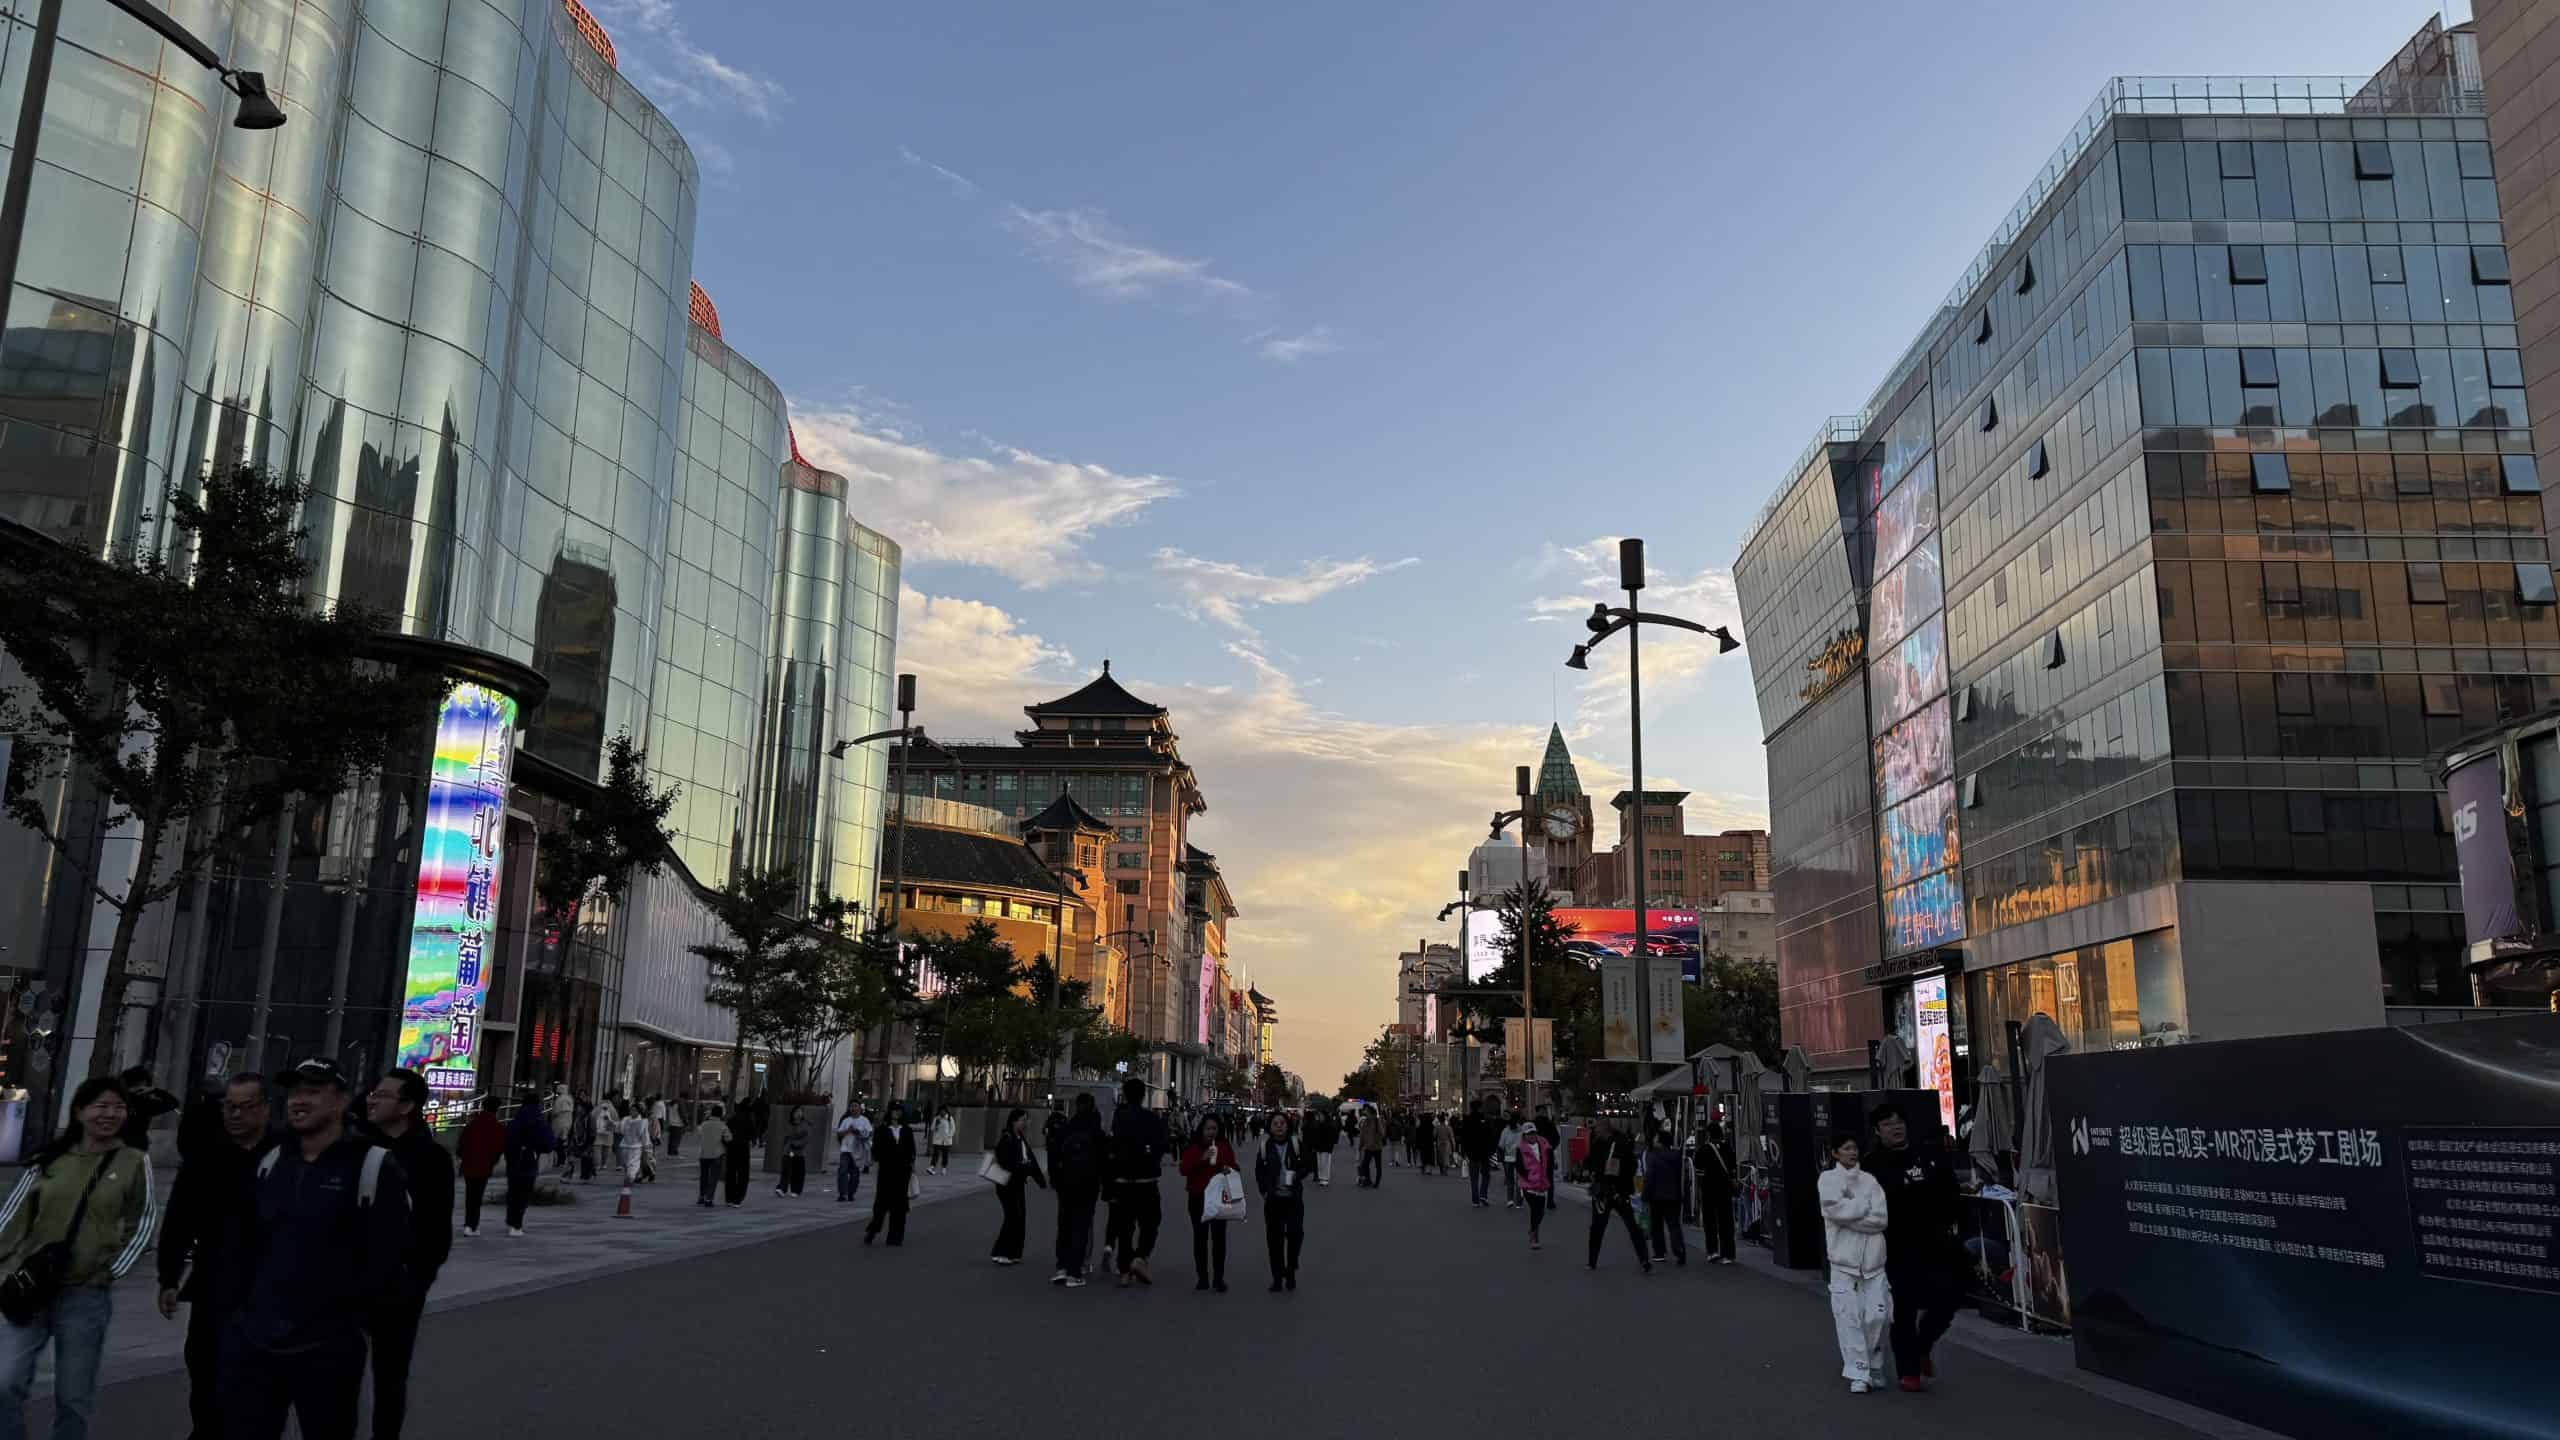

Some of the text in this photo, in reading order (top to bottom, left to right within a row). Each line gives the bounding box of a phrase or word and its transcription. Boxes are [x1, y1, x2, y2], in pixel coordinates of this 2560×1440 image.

[2119, 1124, 2383, 1168] 超级混合现实-MR沉浸式梦工剧场
